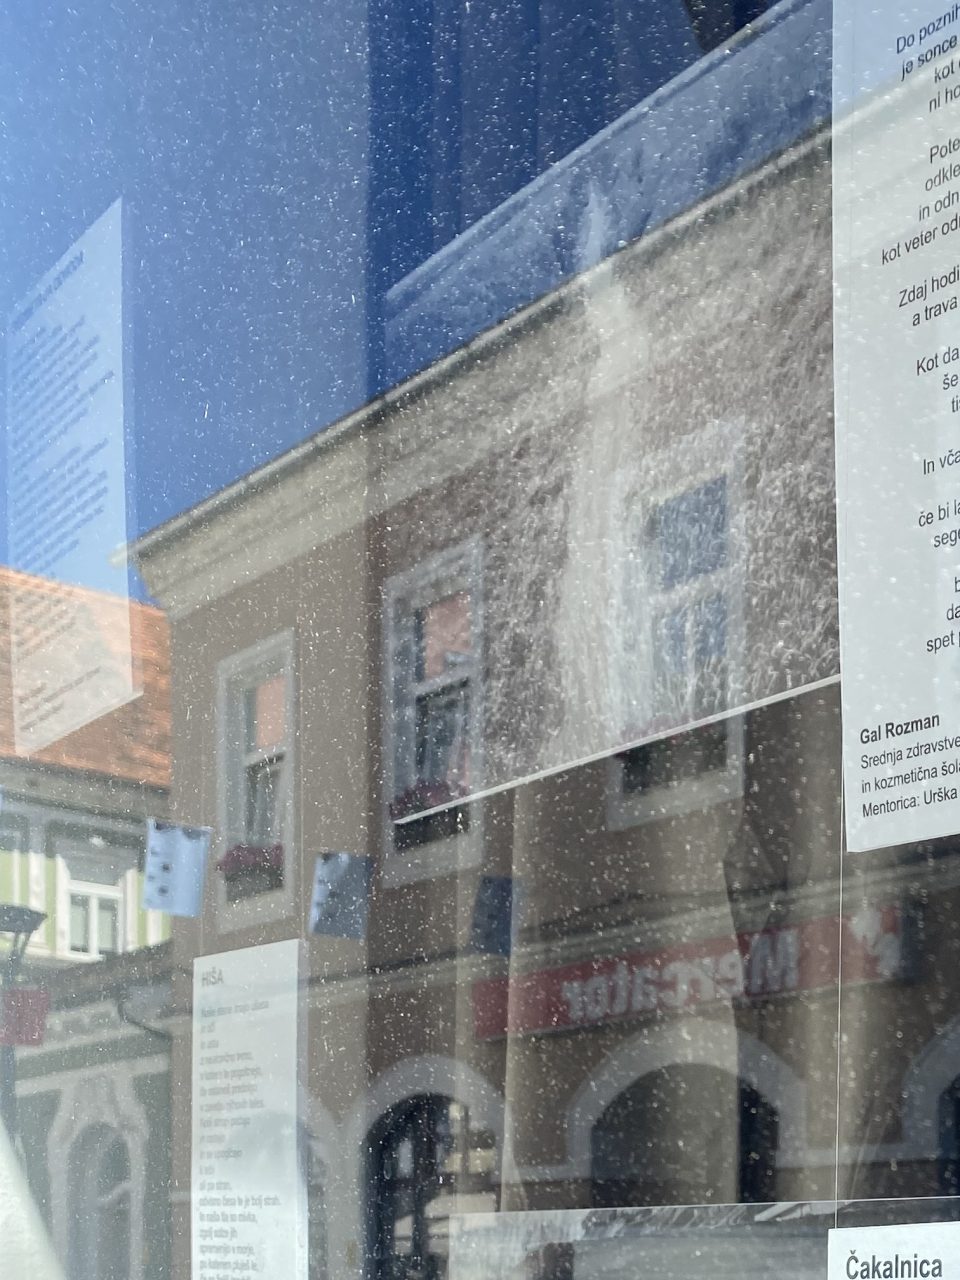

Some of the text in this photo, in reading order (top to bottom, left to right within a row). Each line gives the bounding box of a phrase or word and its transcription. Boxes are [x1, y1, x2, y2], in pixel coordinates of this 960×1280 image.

[928, 91, 940, 113] ni
[918, 205, 930, 222] in
[881, 241, 901, 265] kot
[904, 226, 937, 253] veter
[898, 279, 927, 308] Zdaj
[912, 312, 920, 327] a
[924, 295, 958, 321] trava
[916, 352, 939, 376] Kot
[942, 346, 959, 365] da
[942, 372, 959, 390] še
[923, 458, 935, 475] In
[926, 629, 955, 654] spet
[859, 714, 940, 744] Gal Rozman
[860, 749, 903, 769] Srednja
[861, 779, 871, 794] in
[874, 766, 938, 791] kozmetična
[862, 795, 920, 818] Mentorica:
[923, 786, 958, 805] Urška
[845, 1248, 943, 1280] Čakalnica
